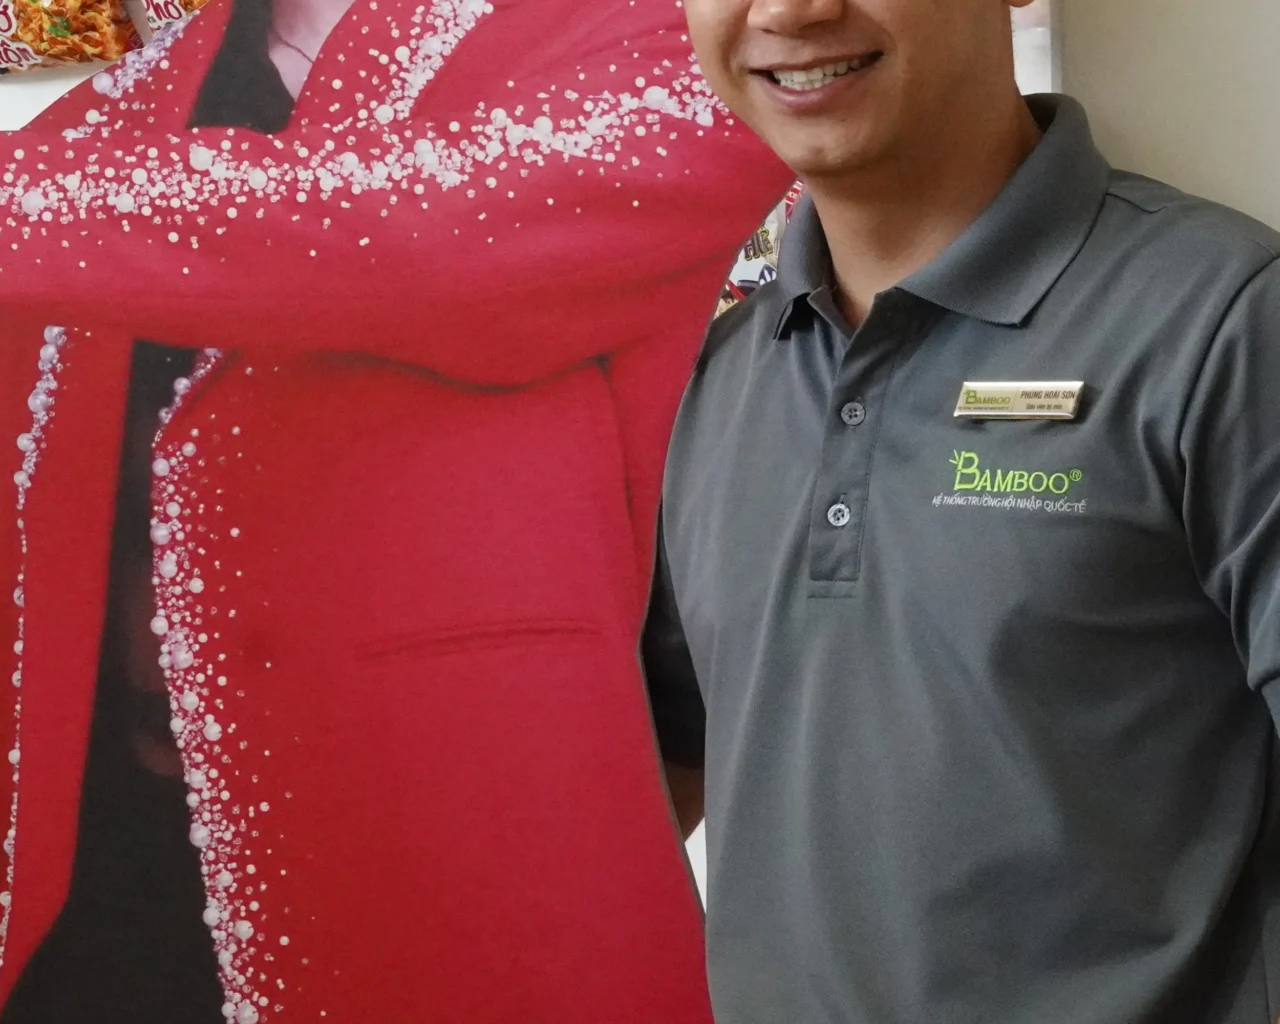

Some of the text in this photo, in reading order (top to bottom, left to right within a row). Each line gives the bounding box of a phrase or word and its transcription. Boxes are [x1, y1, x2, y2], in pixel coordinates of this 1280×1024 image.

[966, 389, 1011, 405] BAMBOO
[953, 450, 1069, 495] BAMBOO
[943, 492, 968, 506] THỐNG
[967, 493, 1001, 507] TRƯỜNG
[1016, 495, 1042, 512] NHẬP
[1044, 496, 1072, 513] QUỐC
